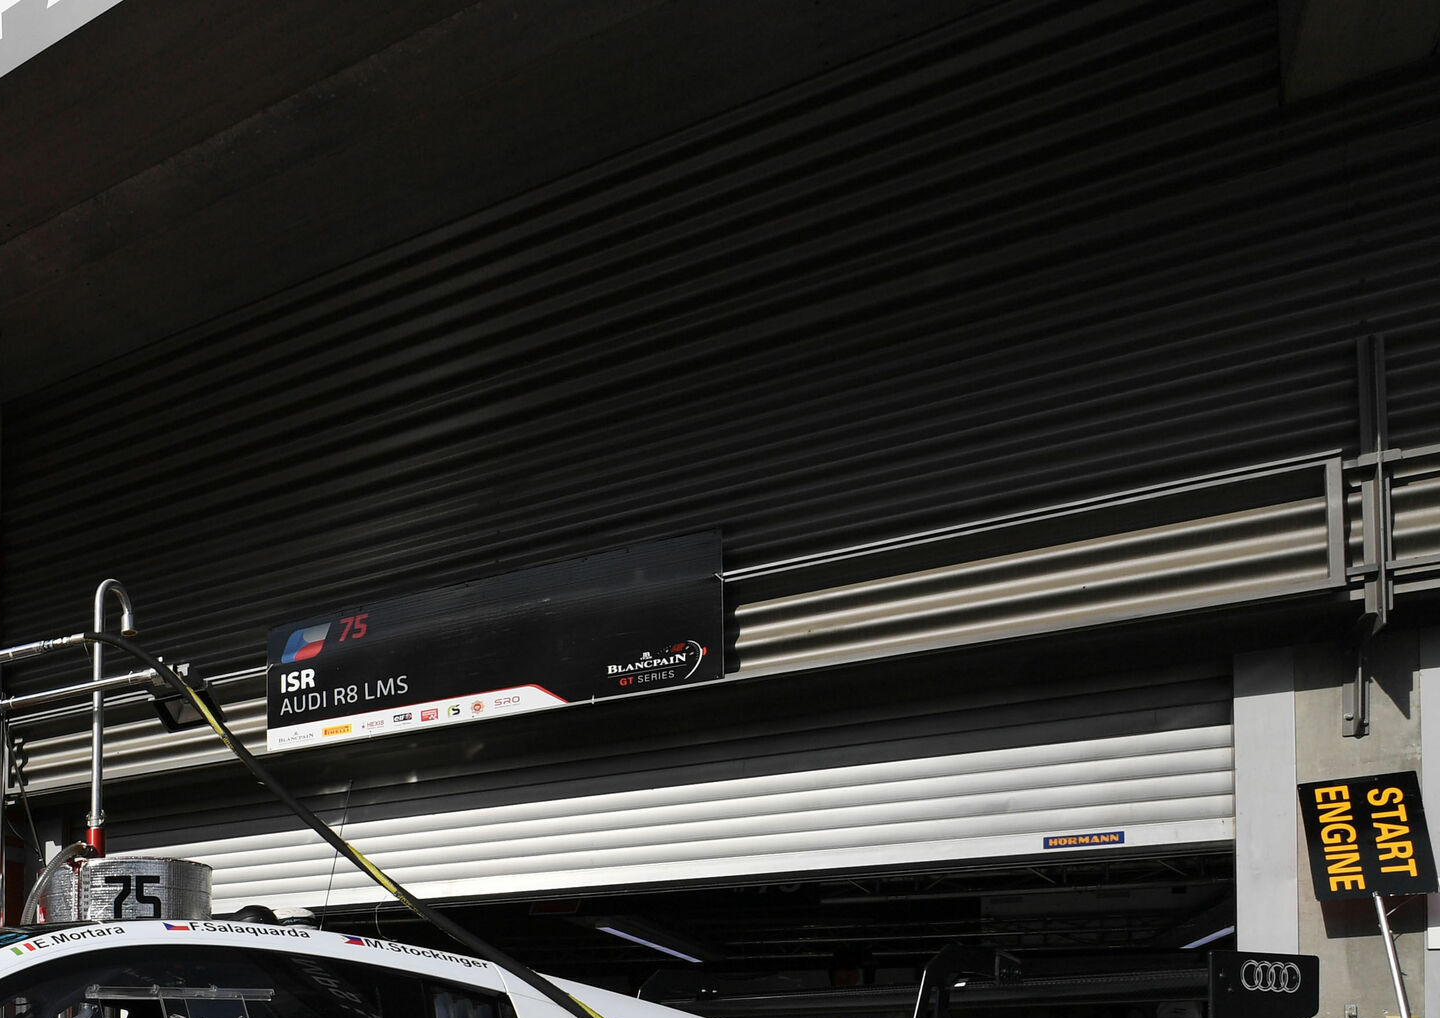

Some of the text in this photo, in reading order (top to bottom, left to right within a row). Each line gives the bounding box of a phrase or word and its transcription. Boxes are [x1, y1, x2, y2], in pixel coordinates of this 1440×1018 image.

[338, 613, 369, 643] 75
[280, 668, 315, 694] ISR
[607, 652, 687, 675] BLANCPAIN
[619, 669, 676, 687] GT SERIES
[279, 675, 409, 716] AUDI R8 LMS
[1314, 785, 1366, 892] ENGINE
[1366, 786, 1418, 878] START
[104, 875, 162, 919] 75
[35, 925, 125, 952] E.Mortara
[189, 920, 311, 940] F.Salaquarda
[365, 937, 491, 971] M.Stockinger
